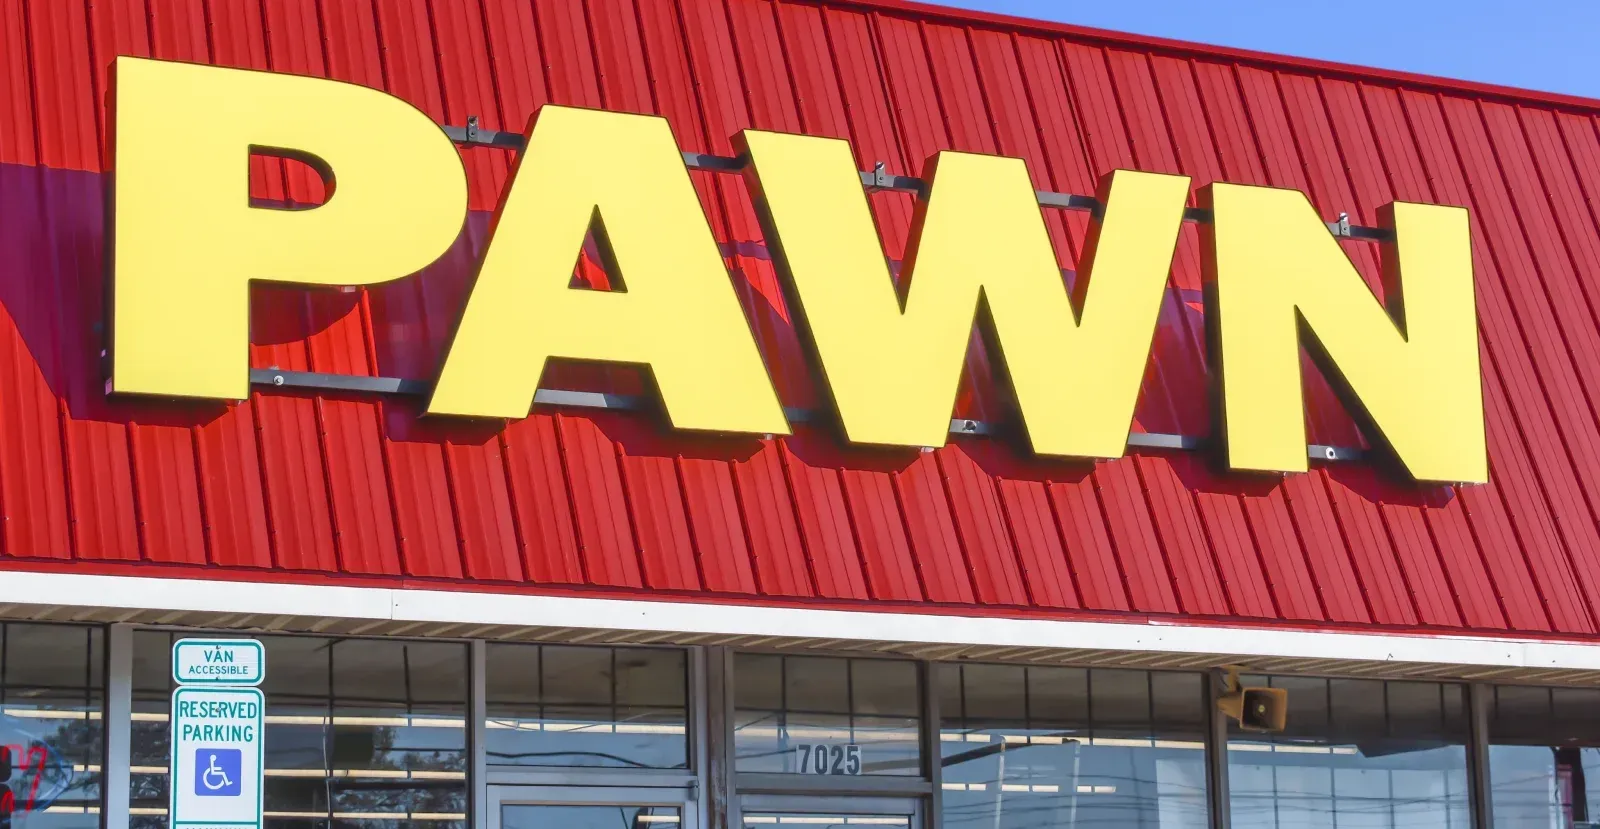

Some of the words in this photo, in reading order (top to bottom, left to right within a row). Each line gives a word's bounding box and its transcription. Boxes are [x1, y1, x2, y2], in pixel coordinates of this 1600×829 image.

[112, 55, 1488, 484] PAWN
[204, 650, 234, 663] VAN
[188, 665, 249, 675] ACCESSIBLE
[179, 701, 257, 719] RESERVED
[183, 725, 253, 742] PARKING
[799, 744, 860, 775] 7025
